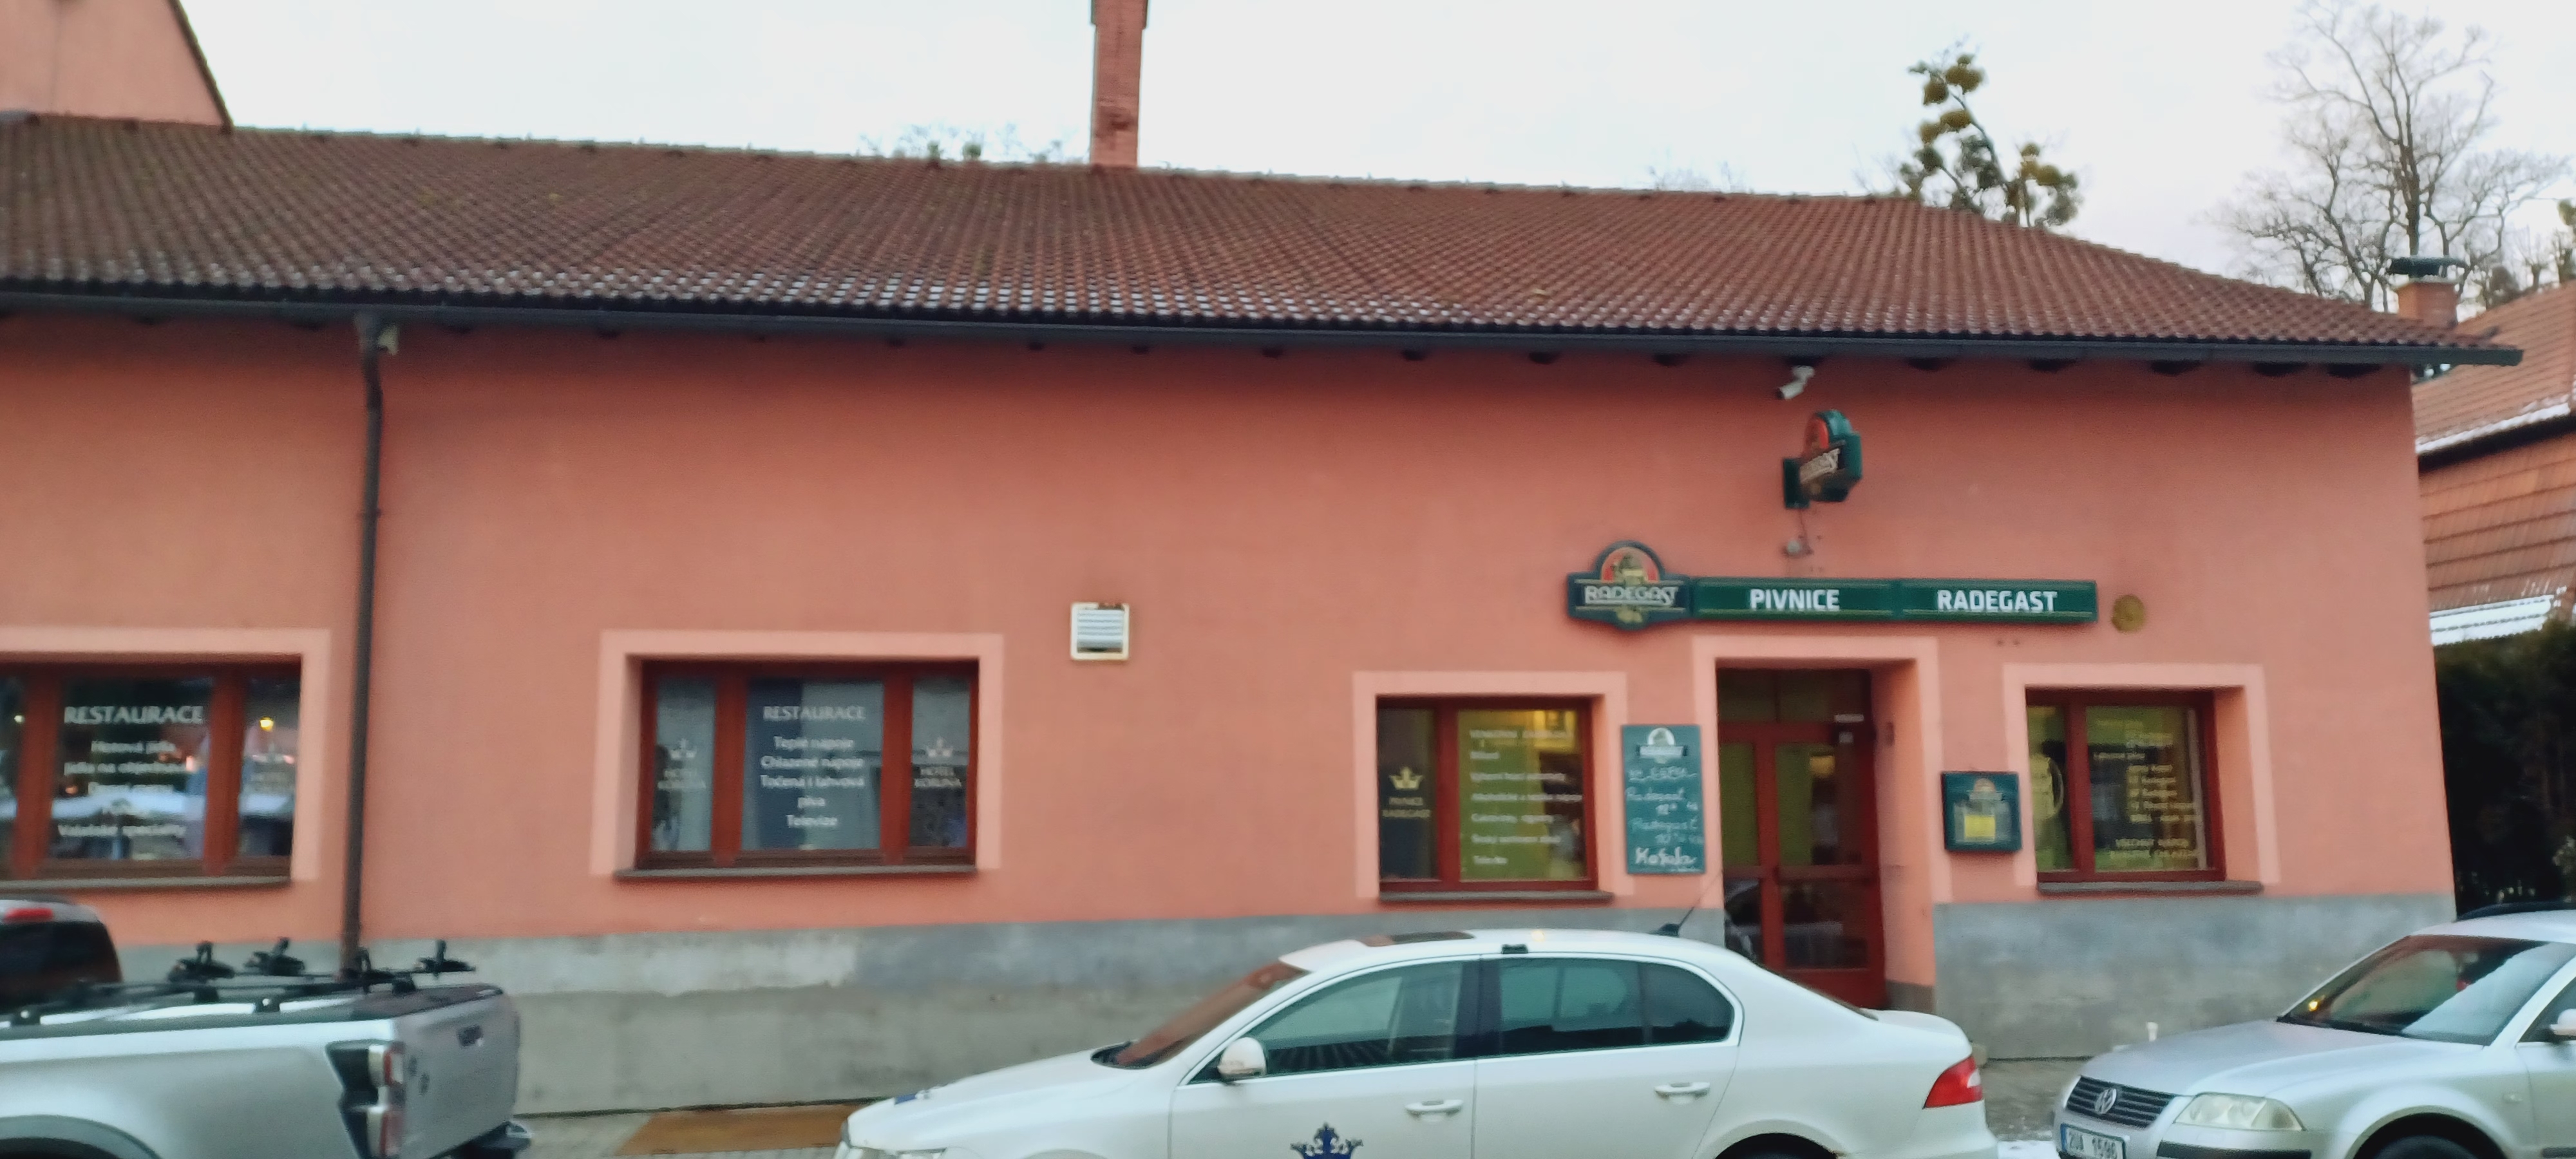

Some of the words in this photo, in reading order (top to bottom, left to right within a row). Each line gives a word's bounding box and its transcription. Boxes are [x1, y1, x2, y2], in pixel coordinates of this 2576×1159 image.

[1584, 585, 1679, 605] RADEGAST
[1750, 589, 1841, 611] PIVNICE
[1937, 589, 2058, 612] RADEGAST
[64, 706, 203, 724] RESTAURACE
[763, 706, 864, 721] RESTAURACE
[798, 796, 826, 809] piva
